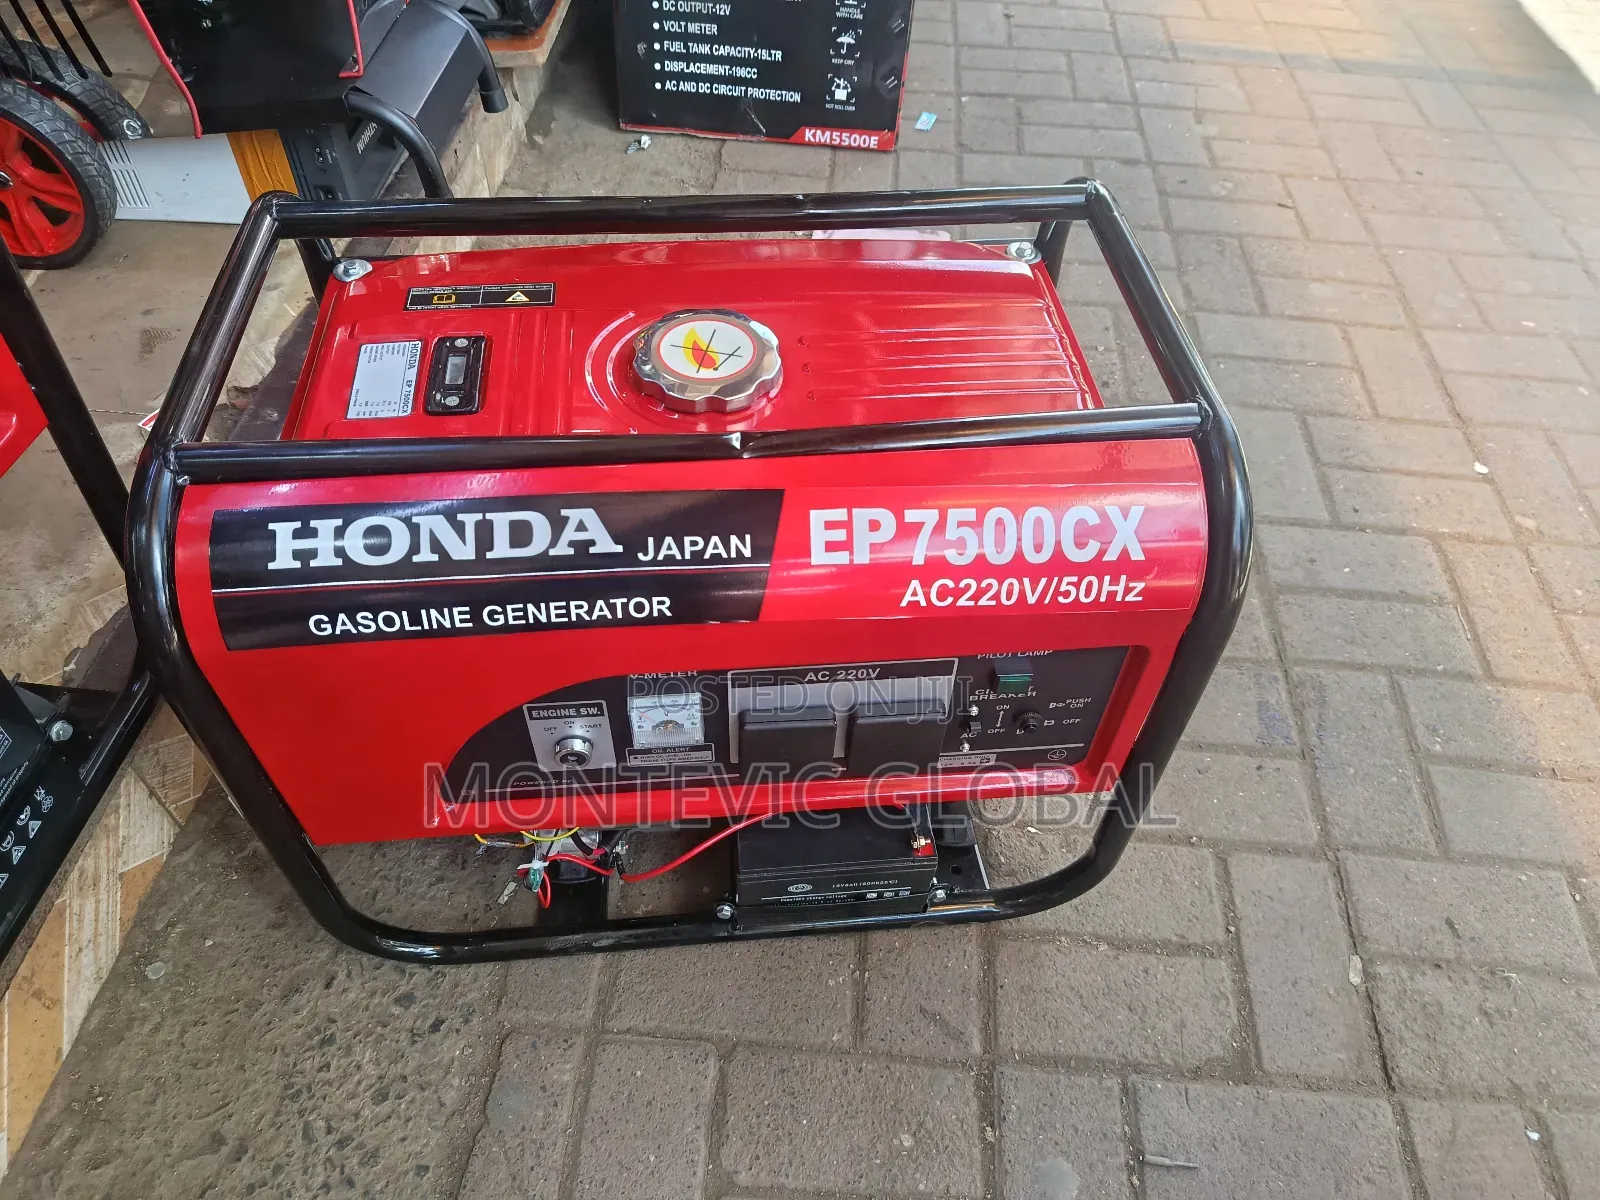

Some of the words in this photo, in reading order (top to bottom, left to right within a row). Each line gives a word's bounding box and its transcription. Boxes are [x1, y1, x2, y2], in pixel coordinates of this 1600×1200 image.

[662, 0, 676, 11] DC
[678, 1, 731, 16] OUTPUT-12V
[663, 20, 686, 32] VOLT
[688, 22, 718, 35] METER
[664, 41, 686, 53] FUEL
[688, 42, 711, 55] TANK
[712, 44, 782, 62] CAPACITY-15LTR
[664, 60, 758, 78] DISPLACEMENT-196CC
[665, 80, 677, 91] AC
[678, 81, 697, 92] AND
[699, 82, 711, 93] DC
[712, 83, 746, 97] CIRCUIT
[748, 87, 801, 103] PROTECTION
[804, 128, 878, 148] KM5500E
[407, 343, 420, 370] HONDA
[406, 380, 413, 388] EP
[401, 390, 412, 414] 7500CX
[266, 507, 623, 570] HONDA
[636, 534, 752, 563] JAPAN
[900, 575, 1145, 608] AC220V/50Hz
[308, 606, 474, 637] GASOLINE
[482, 596, 673, 626] GENERATOR
[804, 670, 830, 682] AC
[836, 668, 881, 680] 220V
[532, 708, 577, 718] ENGINE
[580, 707, 601, 715] SW.
